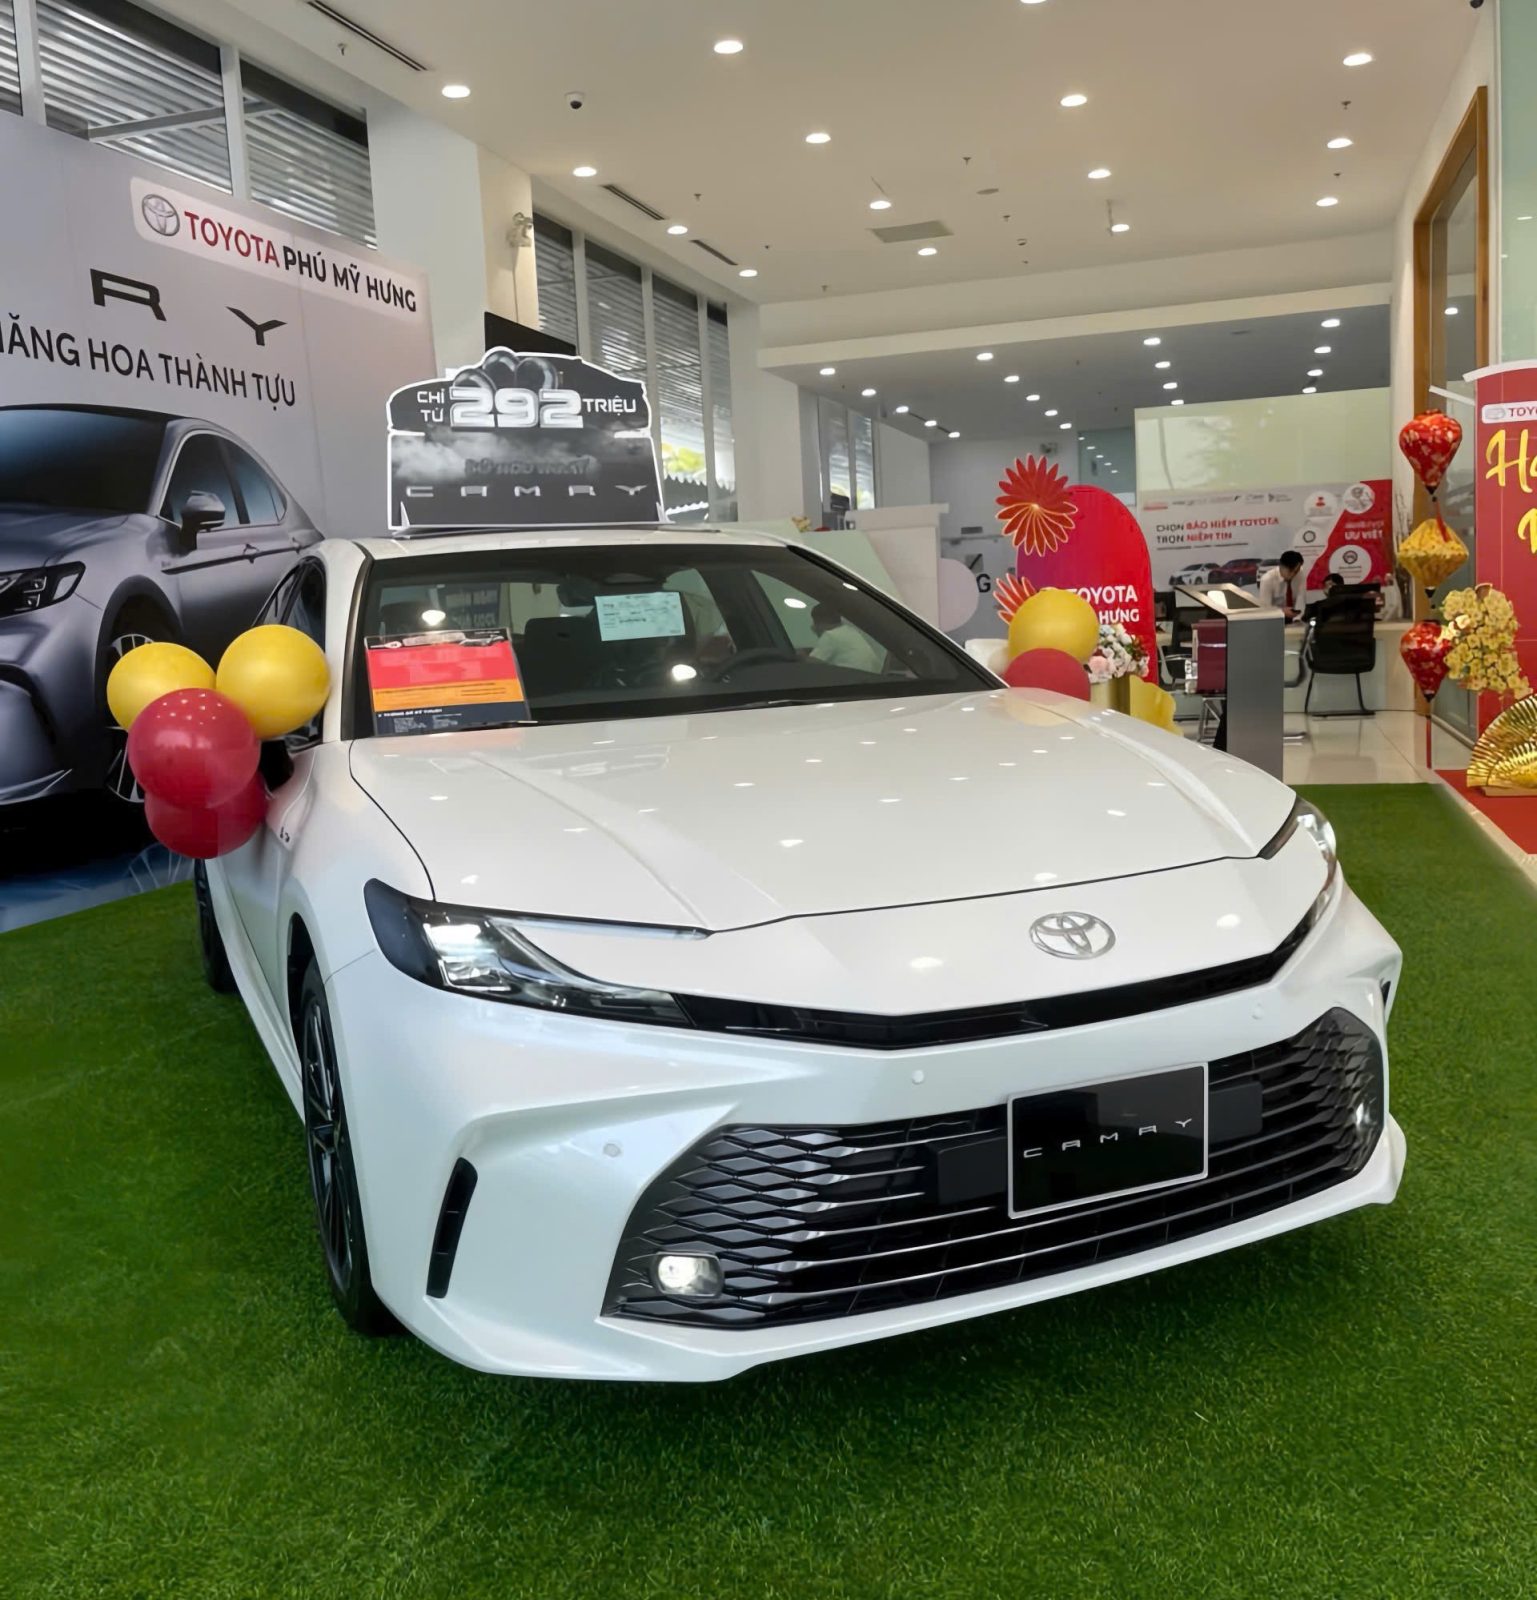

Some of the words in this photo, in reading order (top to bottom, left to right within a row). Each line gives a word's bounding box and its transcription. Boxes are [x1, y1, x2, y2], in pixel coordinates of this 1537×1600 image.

[184, 210, 280, 268] TOYOTA
[282, 245, 326, 282] PHÚ
[332, 262, 360, 293] MỸ
[365, 274, 416, 312] HƯNG
[88, 337, 155, 381] HOA
[158, 352, 248, 398] THÀNH
[251, 372, 296, 411] TỰU
[417, 388, 446, 404] CHỈ
[420, 407, 444, 422] TỪ
[449, 386, 584, 429] 292
[582, 395, 637, 416] TRIỆU
[1508, 406, 1537, 417] TOY
[406, 484, 648, 498] CAMRY
[1066, 584, 1139, 605] OYOTA
[1098, 606, 1140, 625] HƯNG
[1023, 1117, 1193, 1159] CAMRY
